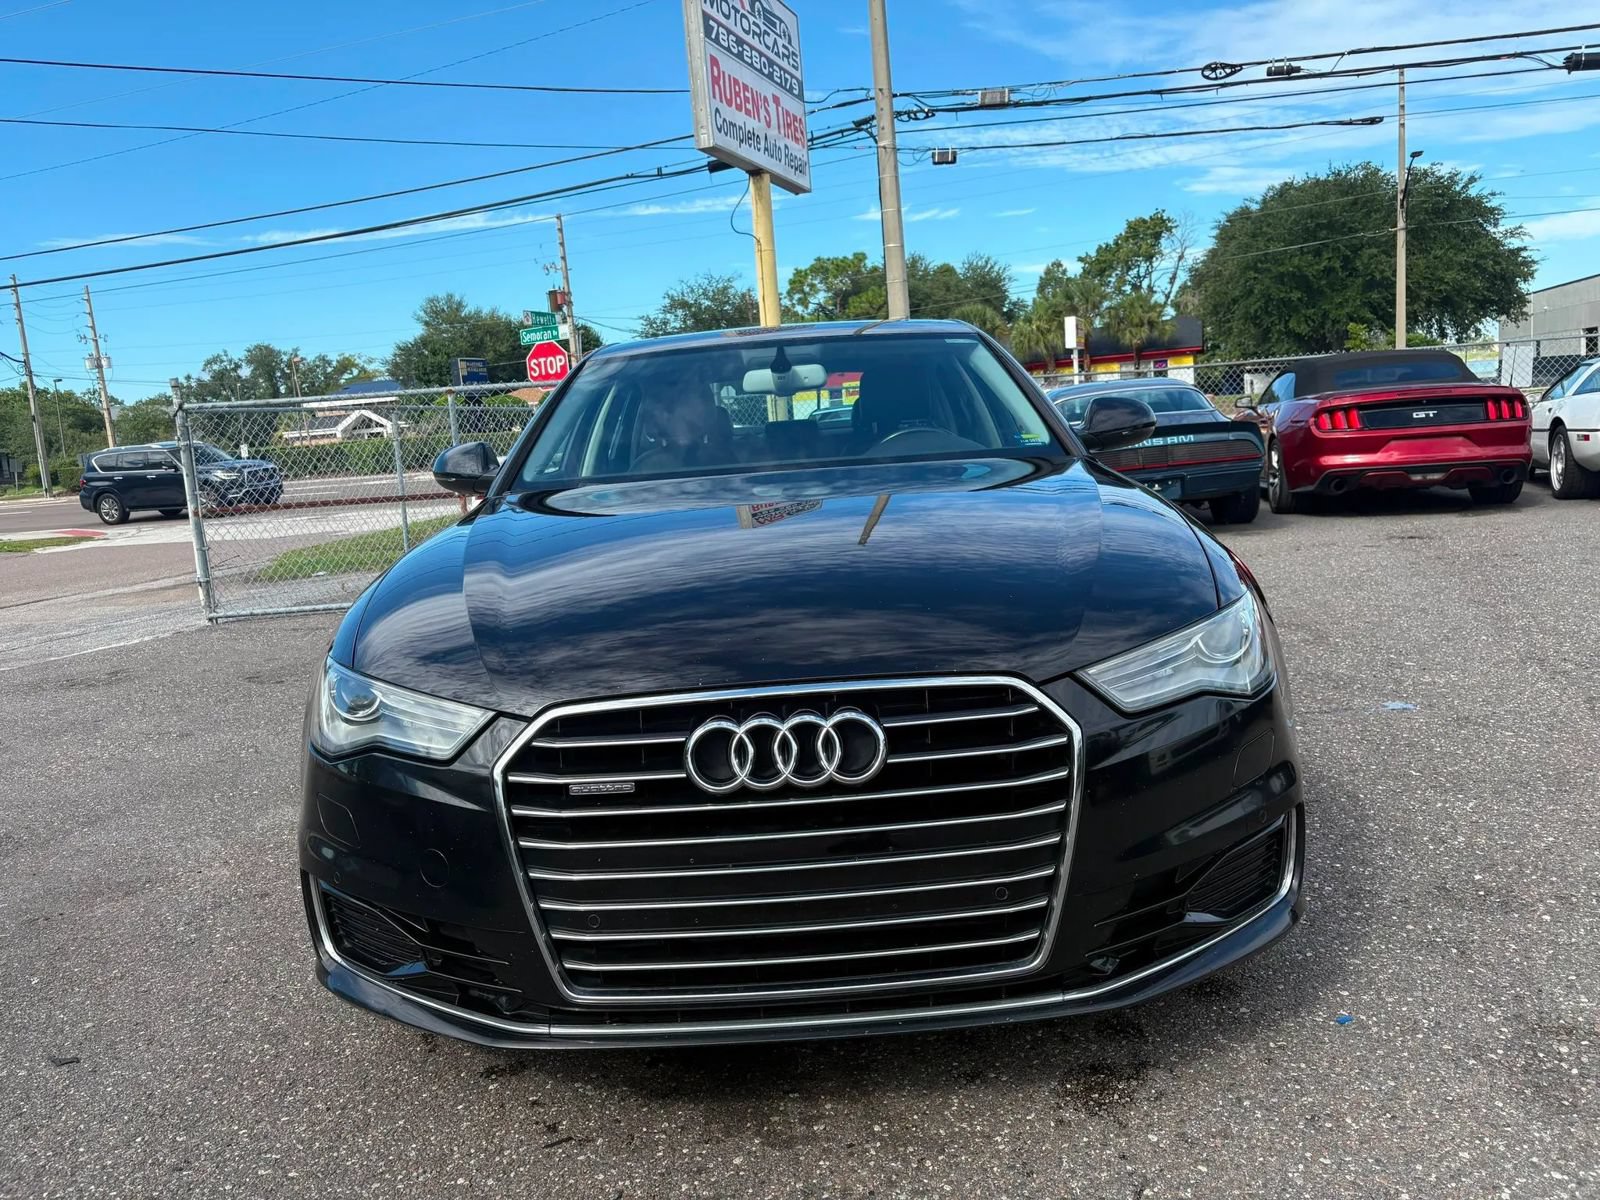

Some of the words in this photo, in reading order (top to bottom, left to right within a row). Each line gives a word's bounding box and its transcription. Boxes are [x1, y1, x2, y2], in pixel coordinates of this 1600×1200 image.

[708, 20, 799, 96] 786-280-2179
[709, 53, 772, 129] RUBEN'S
[772, 93, 806, 149] TIRES
[714, 106, 761, 152] Complete
[763, 132, 783, 163] Auto
[783, 143, 807, 176] Repair
[522, 330, 553, 343] Semoran
[530, 355, 565, 377] STOP
[1412, 410, 1438, 418] GT
[1167, 434, 1194, 445] AM
